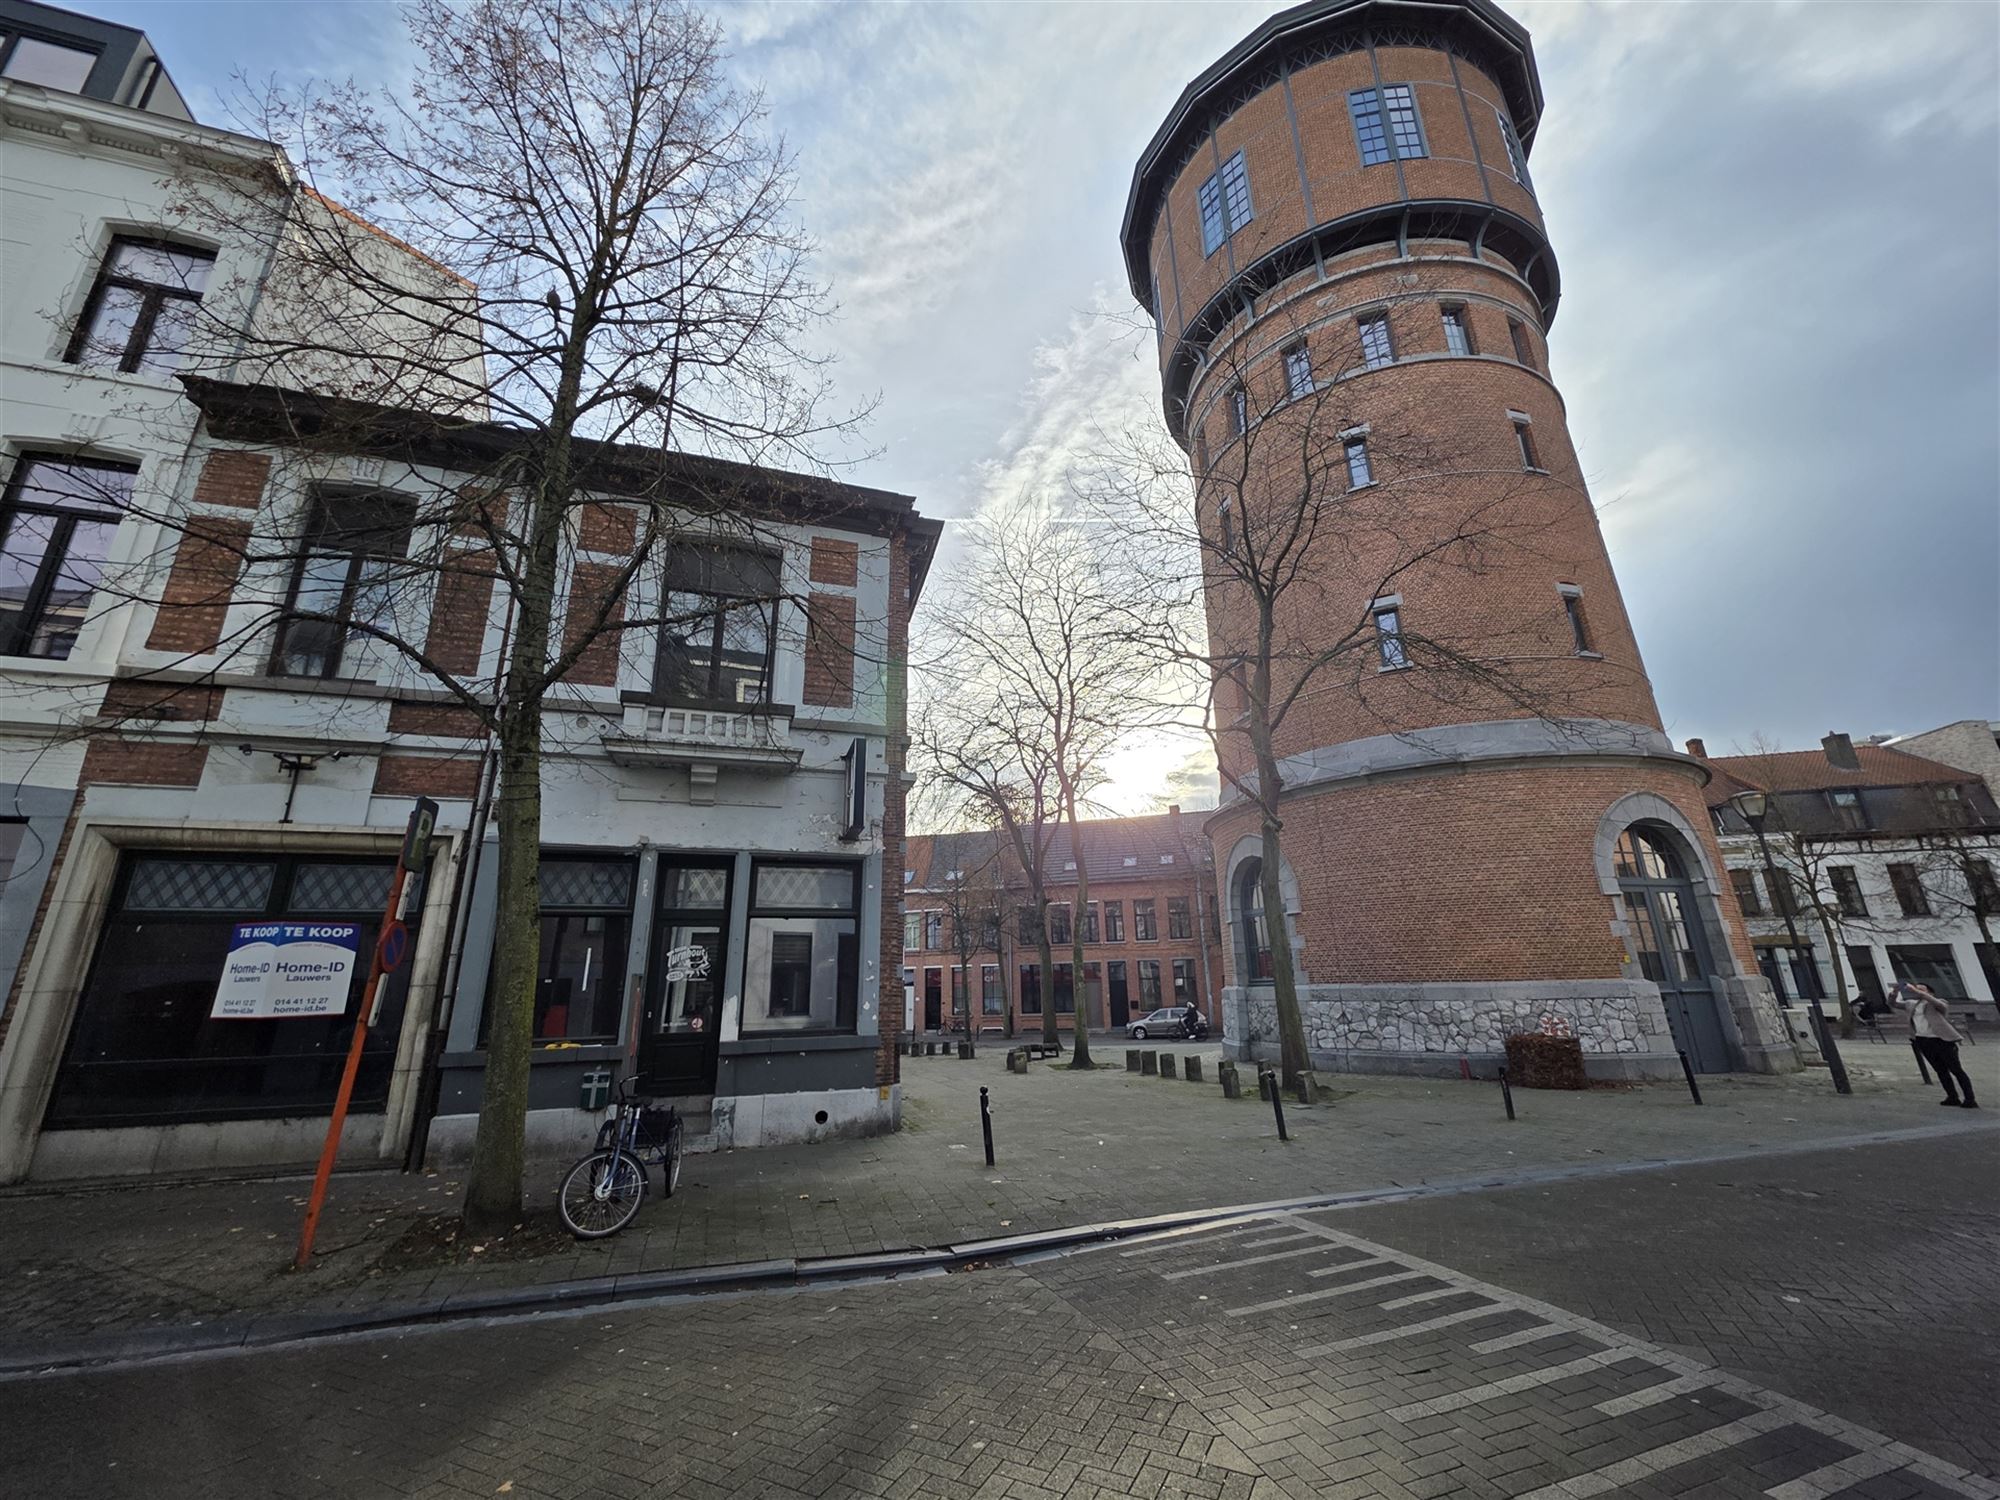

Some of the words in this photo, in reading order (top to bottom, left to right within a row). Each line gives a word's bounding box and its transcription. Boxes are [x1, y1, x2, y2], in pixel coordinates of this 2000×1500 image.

[241, 928, 251, 938] TE
[253, 927, 279, 937] KOOP
[284, 927, 305, 937] TE
[308, 927, 354, 937] KOOP
[230, 963, 270, 973] Home-ID
[275, 962, 345, 973] Home-ID
[233, 975, 261, 983] Lauwers
[285, 974, 332, 982] Lauwers
[273, 1005, 327, 1014] home-id.be
